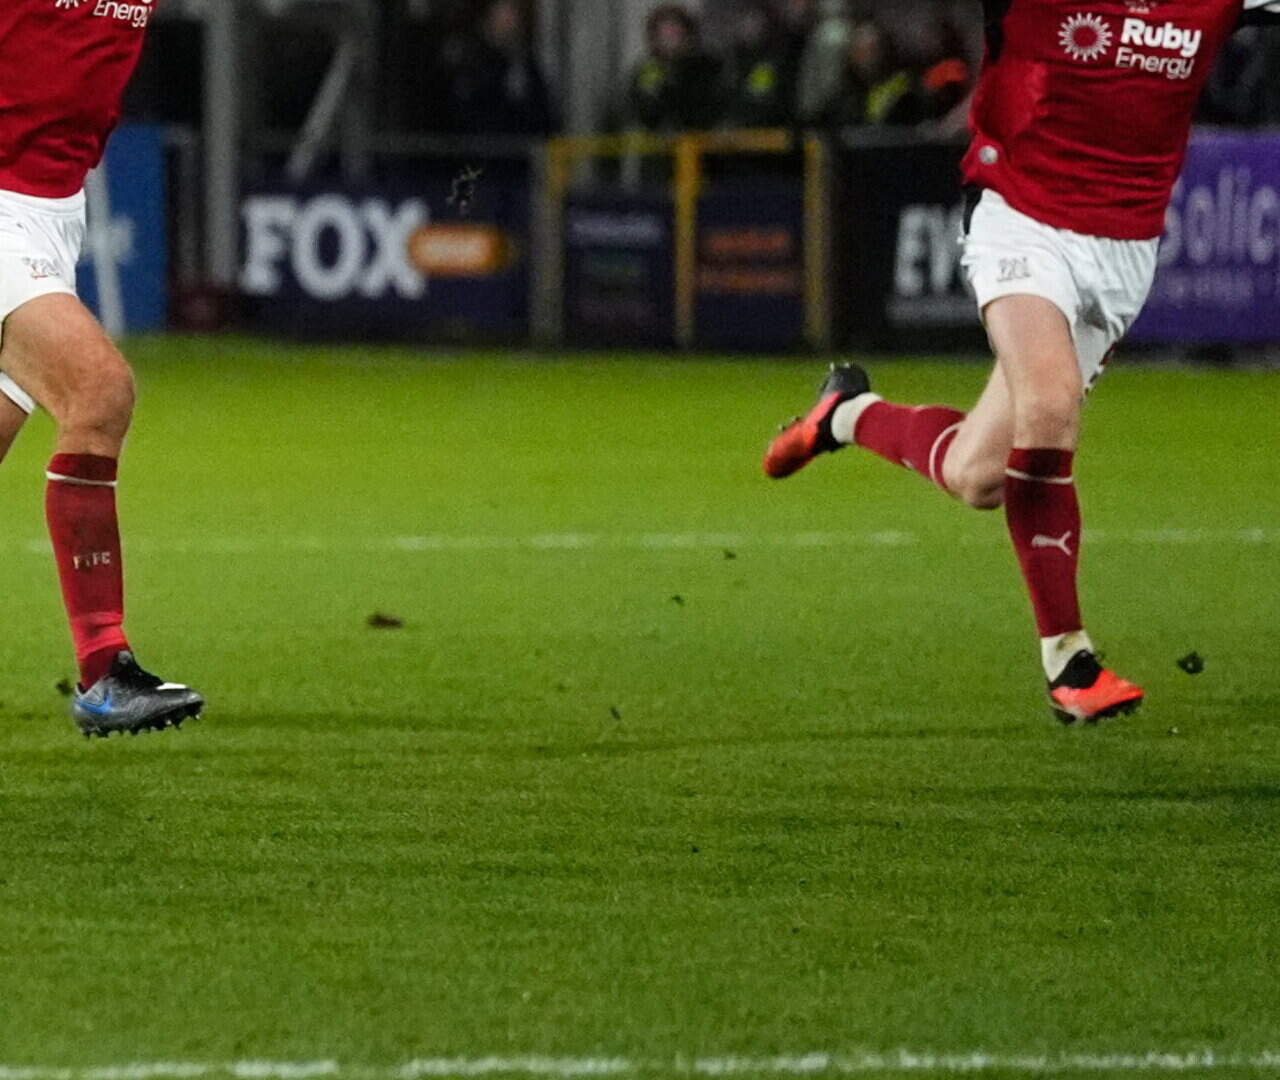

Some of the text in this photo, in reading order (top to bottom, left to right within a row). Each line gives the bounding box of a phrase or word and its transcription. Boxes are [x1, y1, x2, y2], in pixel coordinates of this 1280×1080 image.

[1120, 18, 1202, 58] Ruby
[1115, 47, 1195, 80] Energy
[240, 193, 431, 300] FOX
